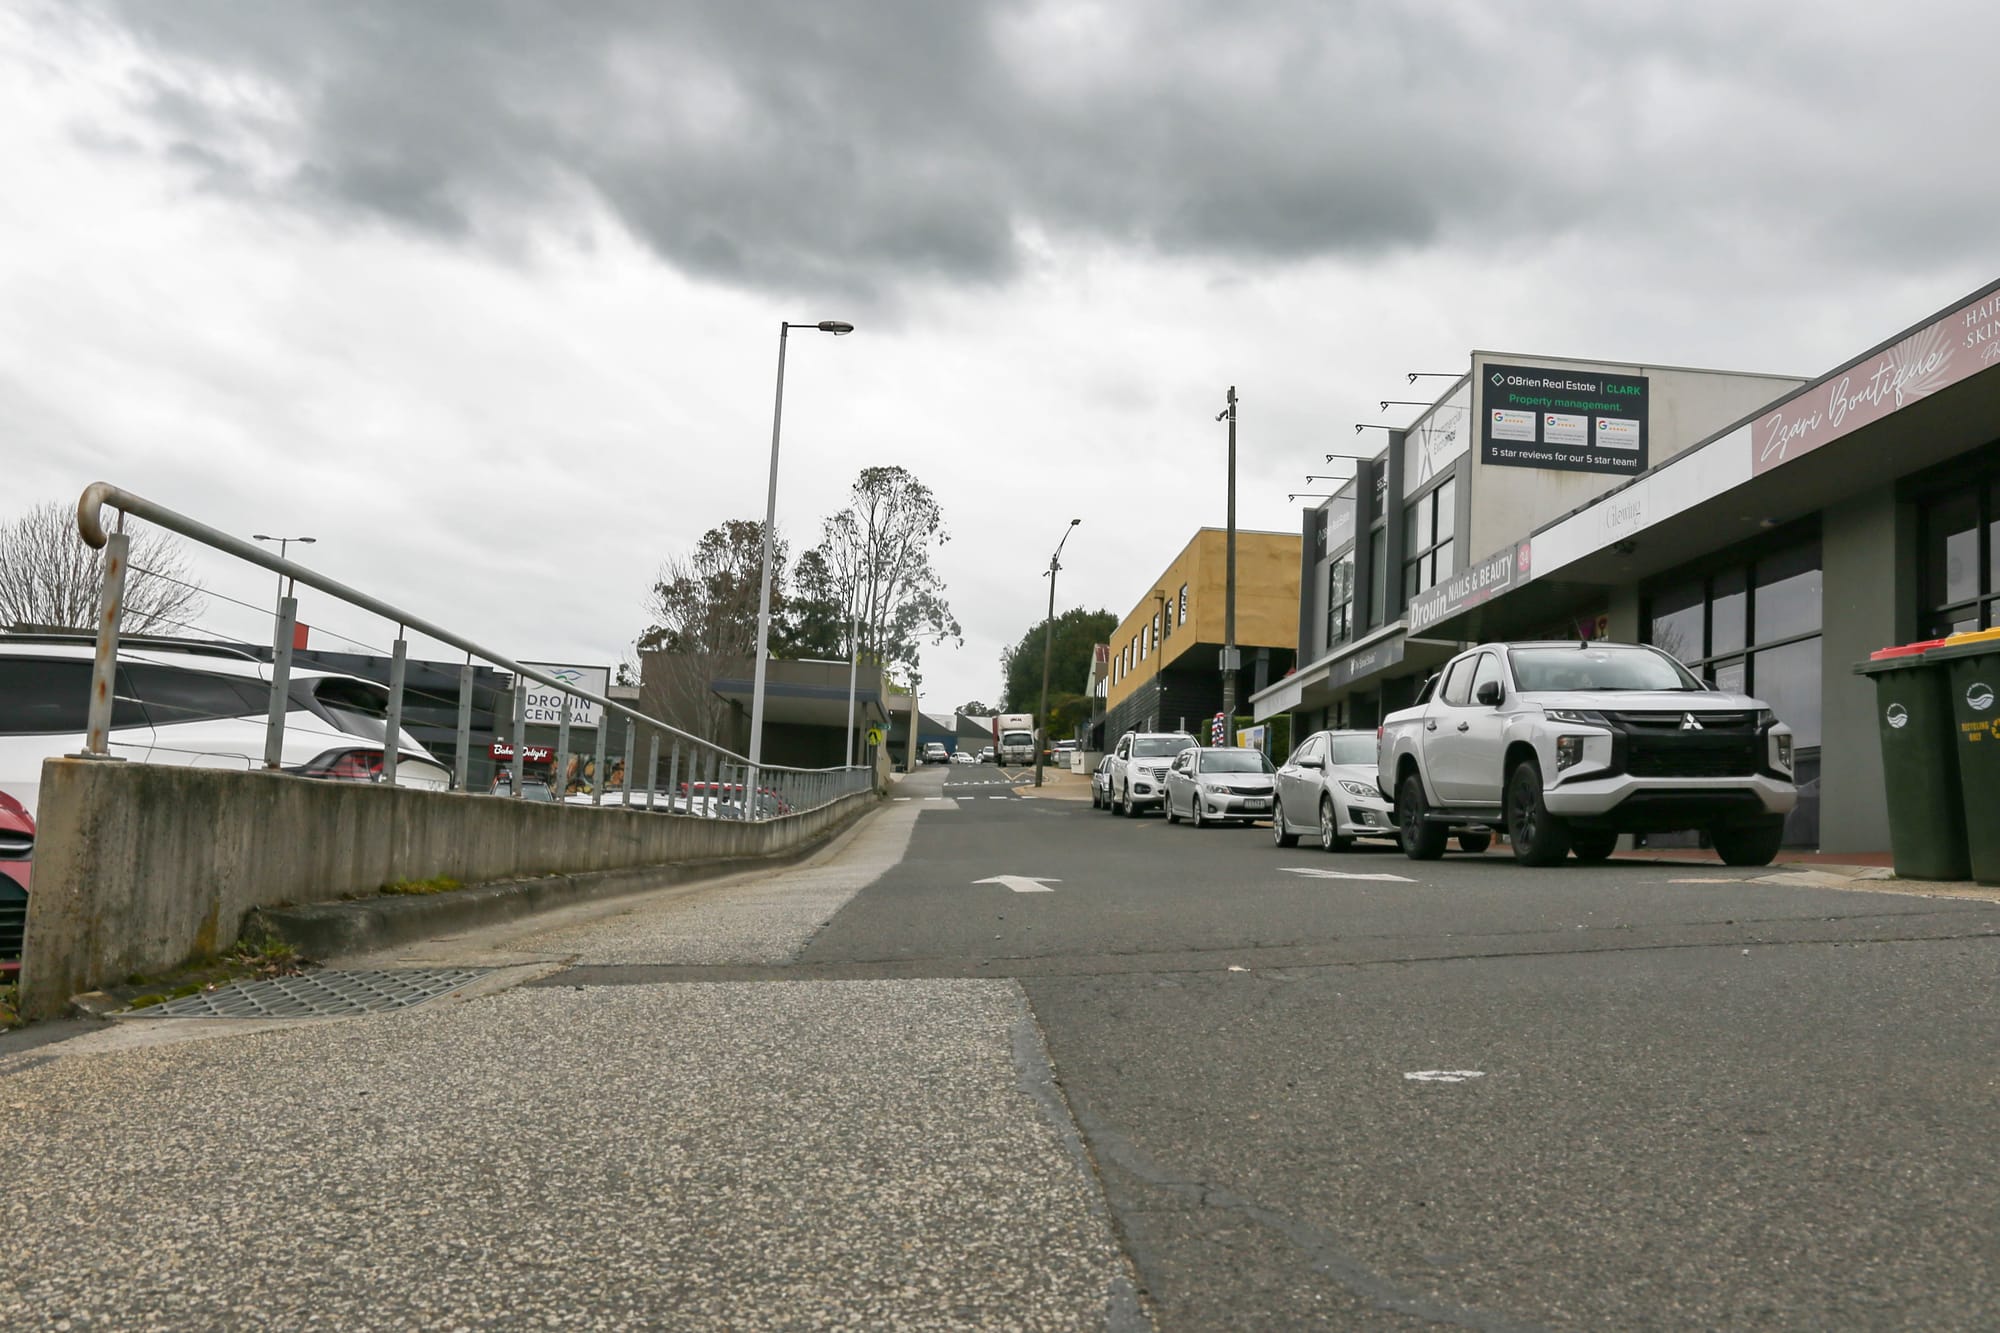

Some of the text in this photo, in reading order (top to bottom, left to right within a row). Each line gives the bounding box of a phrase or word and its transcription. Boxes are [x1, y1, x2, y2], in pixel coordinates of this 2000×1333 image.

[1507, 375, 1641, 396] OBrien Real Estate CLARK
[1828, 352, 1943, 428] Boutique
[1509, 393, 1623, 412] Property management.
[1491, 447, 1637, 467] 5 star reviews for our 5 star team!
[1411, 591, 1447, 630] Drouin
[1448, 576, 1470, 602] NAILS
[1471, 572, 1478, 591] &
[1480, 554, 1513, 587] BEAUTY
